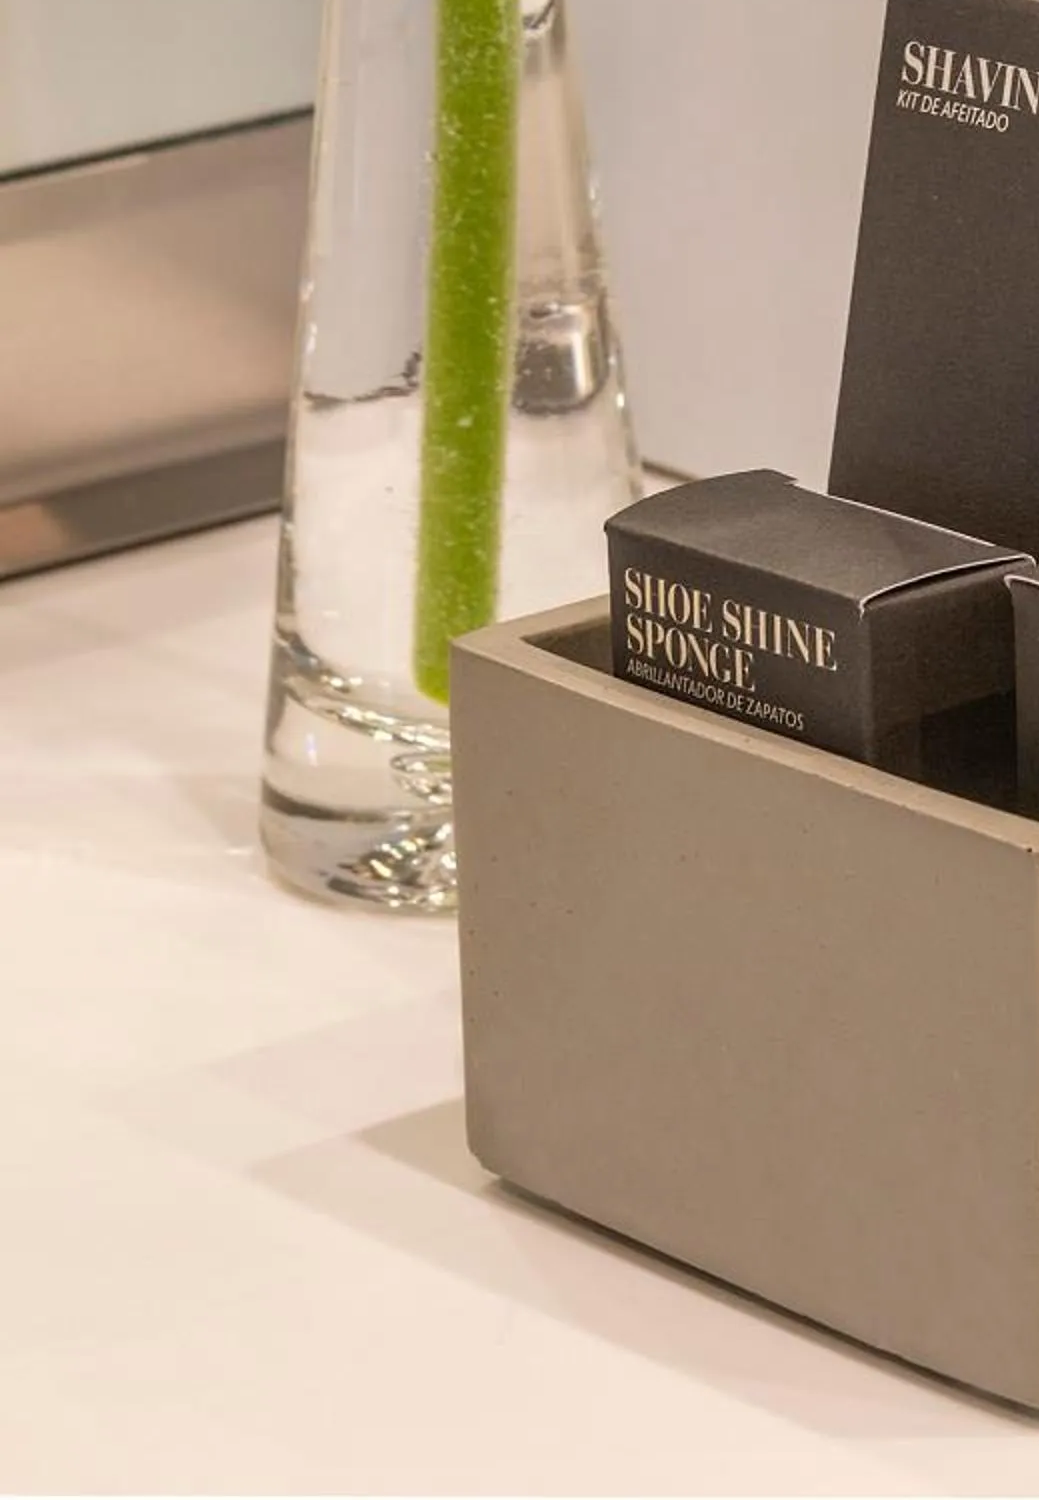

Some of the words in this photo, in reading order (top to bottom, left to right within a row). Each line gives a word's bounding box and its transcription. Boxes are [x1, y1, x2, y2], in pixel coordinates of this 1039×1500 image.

[896, 89, 921, 110] KIT
[920, 94, 941, 116] DE
[940, 100, 1009, 132] AFEITADO
[624, 566, 713, 633] SHOE
[722, 599, 838, 672] SHINE
[626, 613, 757, 693] SPONGE
[627, 658, 725, 707] ABRILLANTADOR
[725, 690, 745, 714] DE
[745, 697, 804, 731] ZAPATOS
